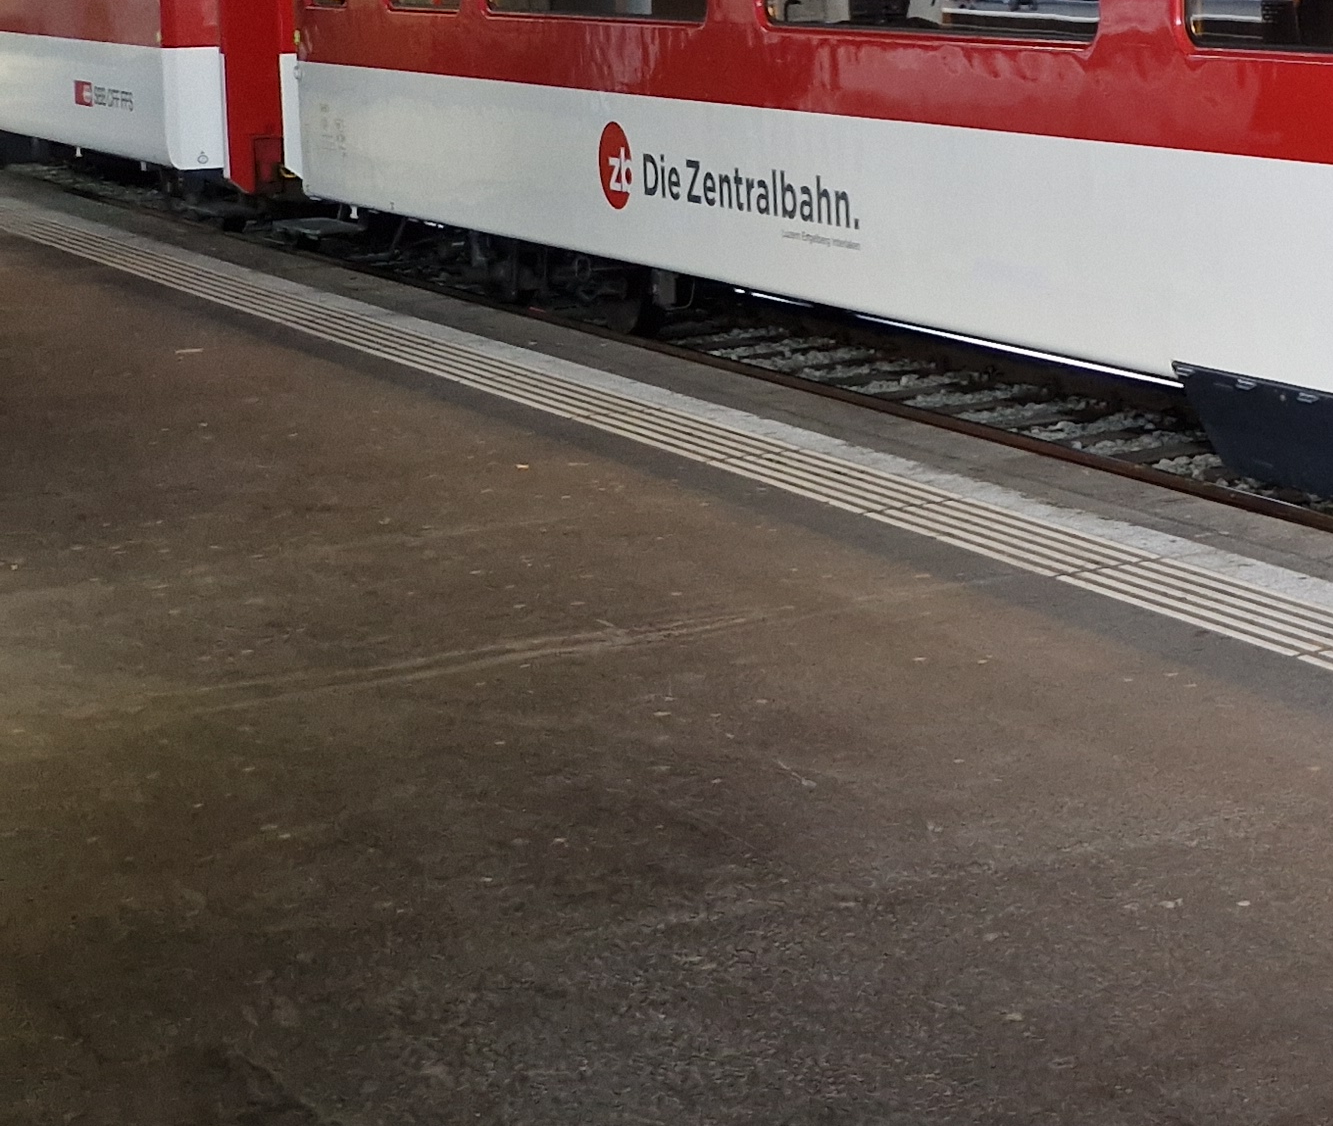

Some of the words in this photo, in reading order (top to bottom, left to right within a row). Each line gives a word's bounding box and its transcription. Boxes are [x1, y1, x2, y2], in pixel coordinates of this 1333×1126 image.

[608, 146, 633, 194] zb
[642, 153, 681, 200] Die
[685, 158, 860, 230] Zentralbahn.
